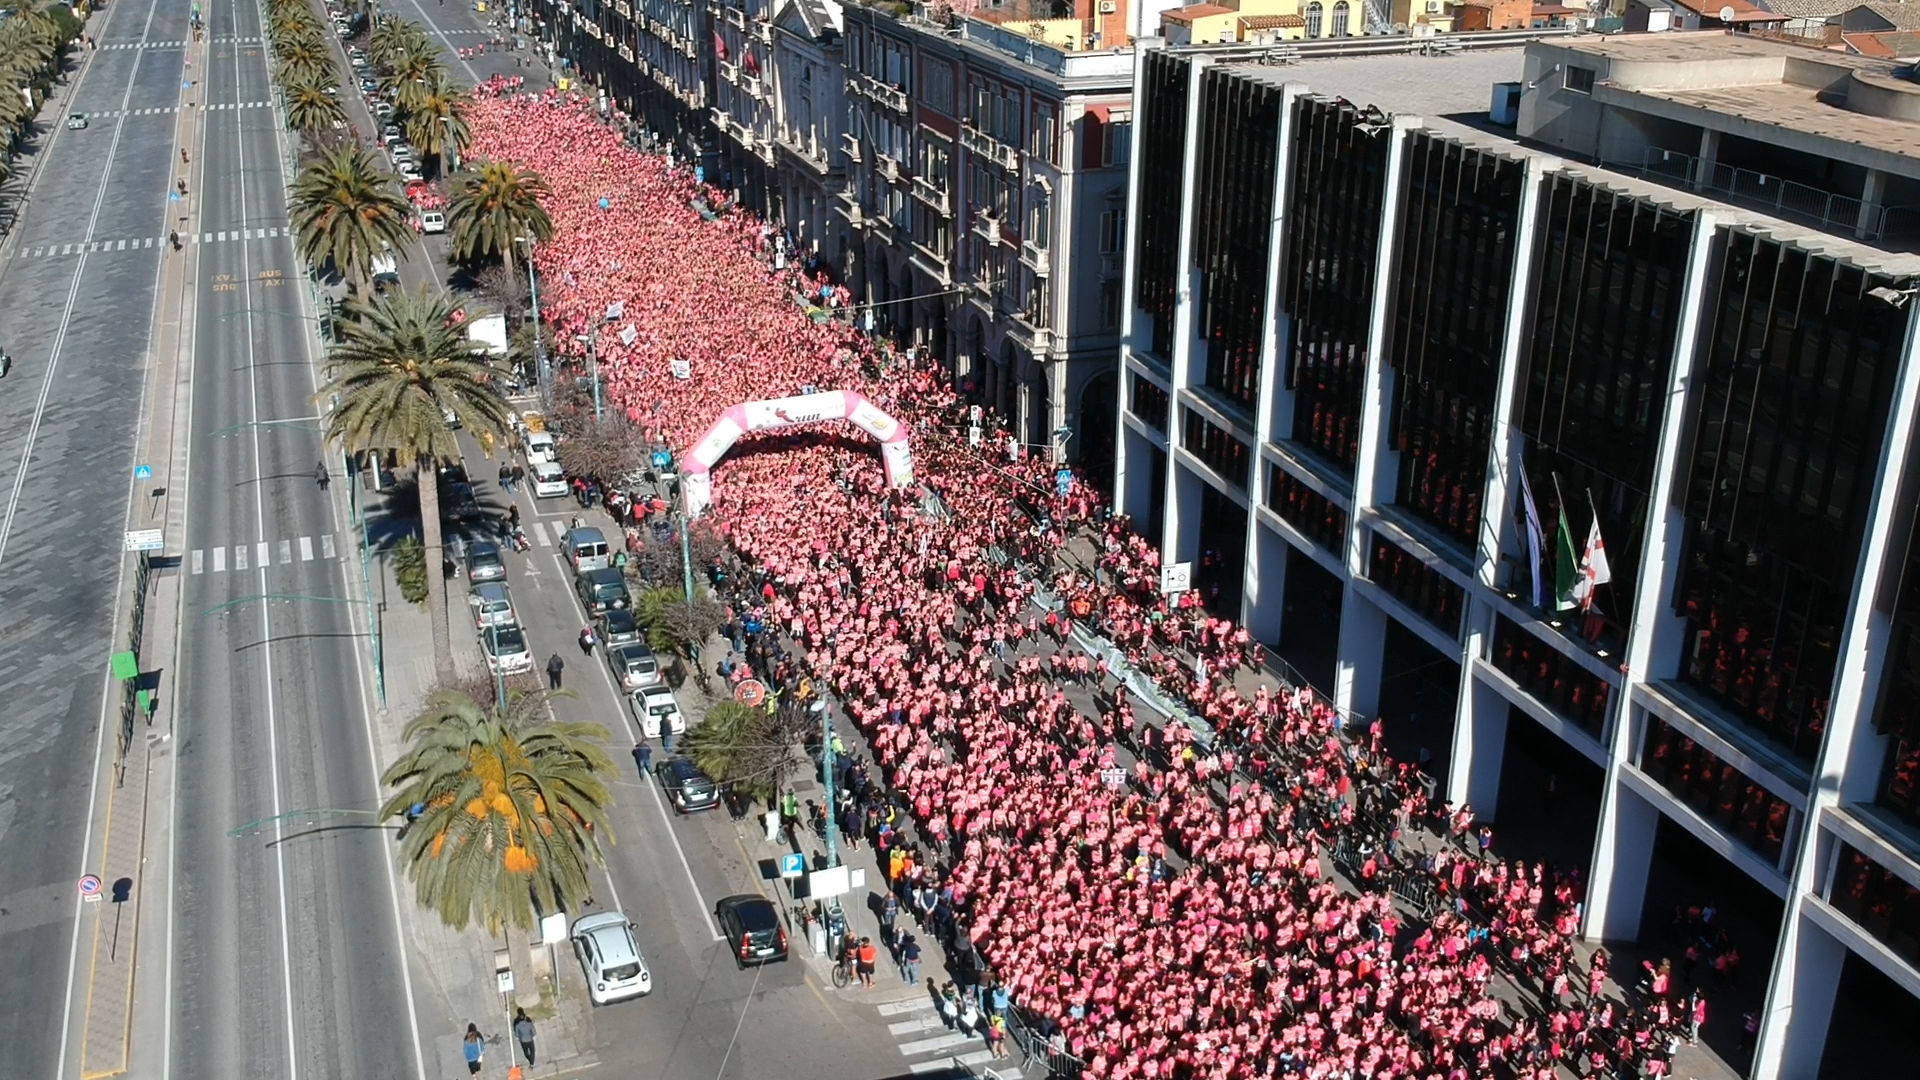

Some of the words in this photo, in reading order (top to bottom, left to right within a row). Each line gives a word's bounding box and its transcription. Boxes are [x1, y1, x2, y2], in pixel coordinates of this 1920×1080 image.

[259, 269, 281, 278] BUS
[213, 283, 237, 292] BUS
[785, 855, 799, 870] P
